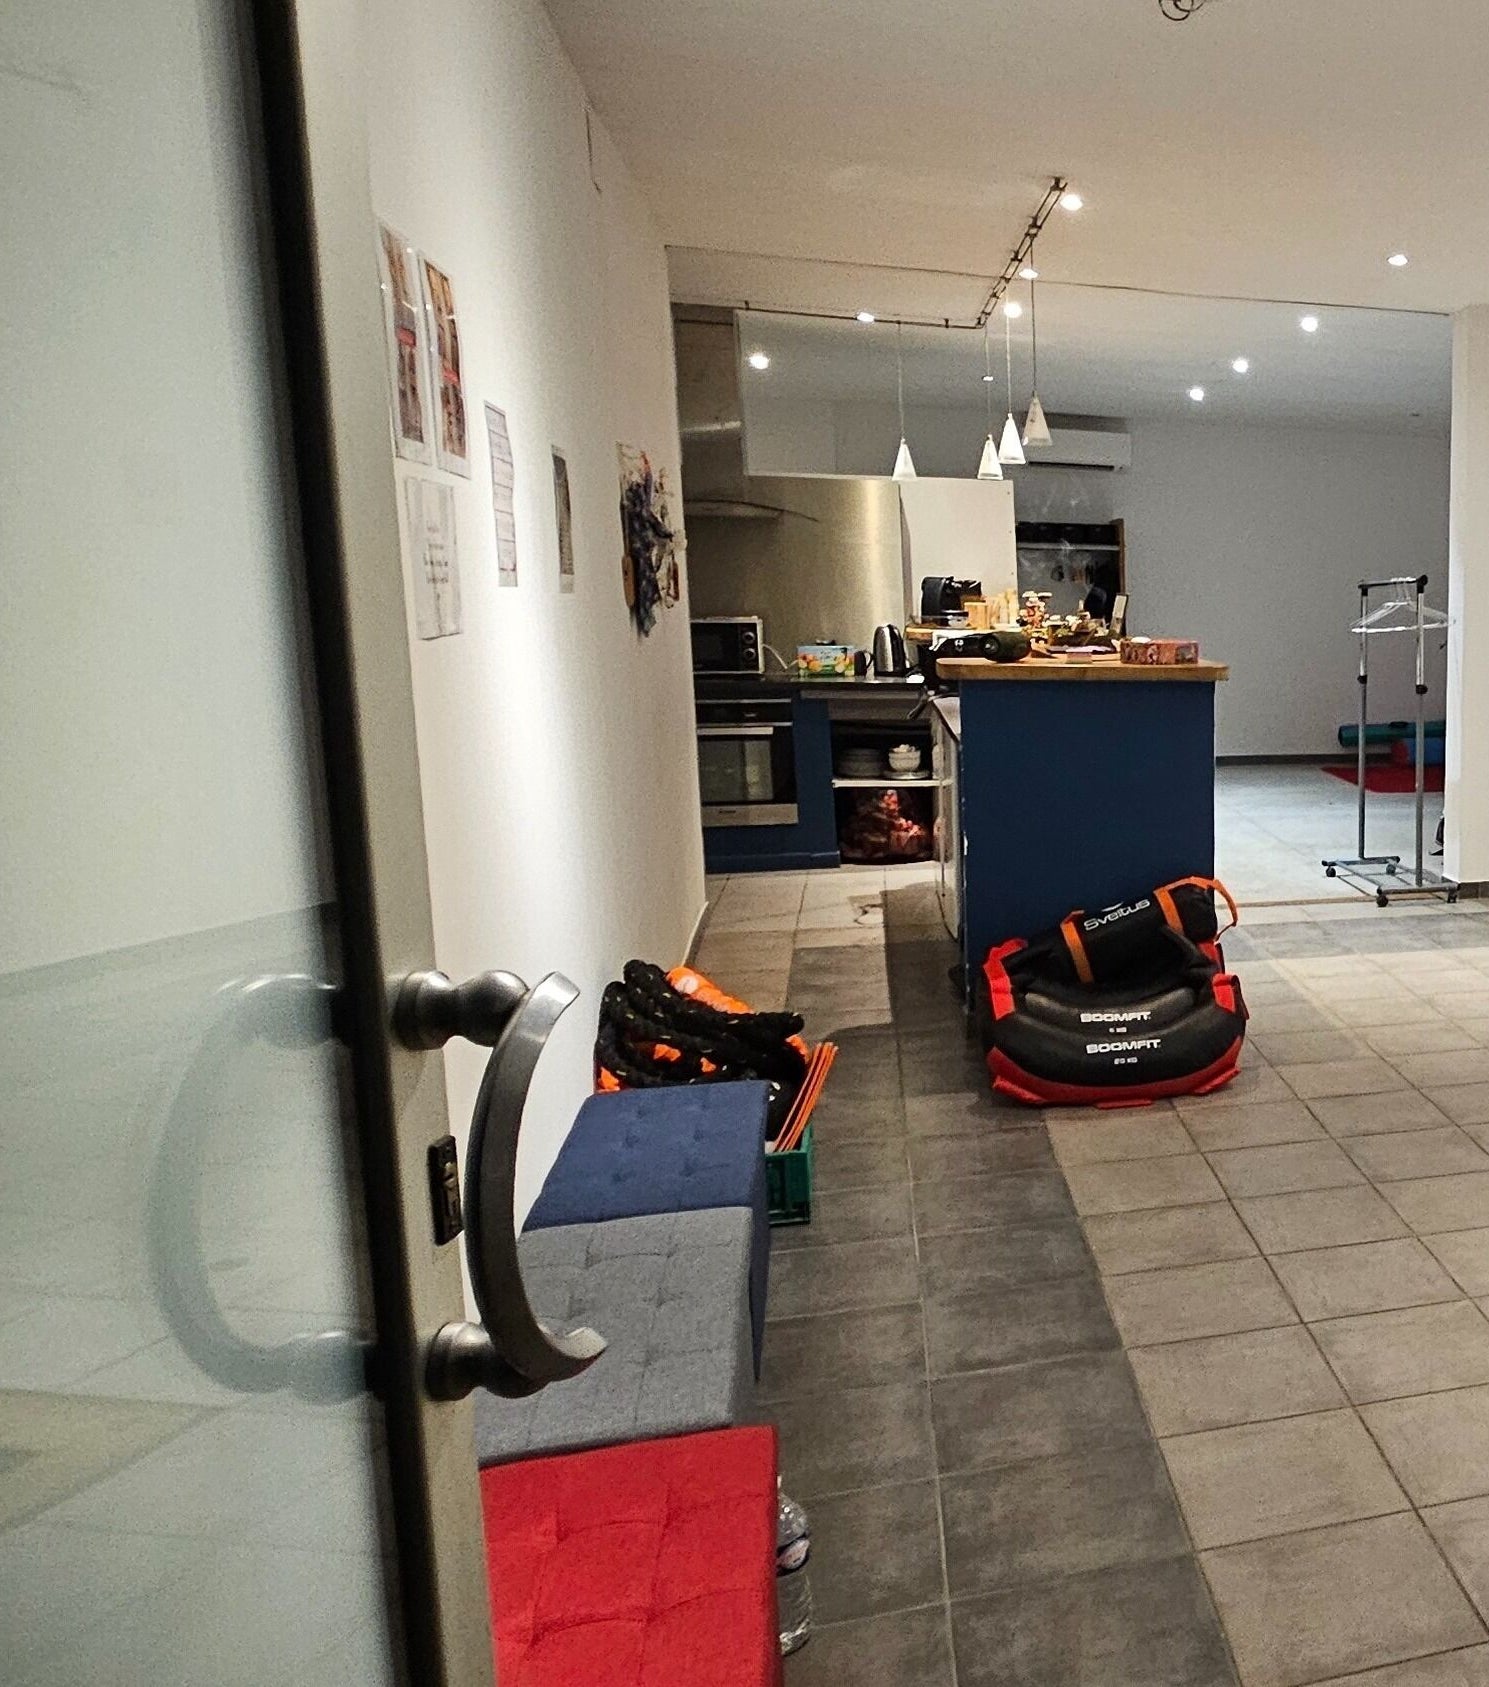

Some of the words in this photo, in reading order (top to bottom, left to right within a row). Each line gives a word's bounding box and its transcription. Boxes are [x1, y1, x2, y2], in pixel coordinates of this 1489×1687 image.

[1083, 899, 1151, 931] Sveltus
[1080, 1011, 1151, 1023] BOOMFIT
[1086, 1039, 1161, 1054] BOOMFIT
